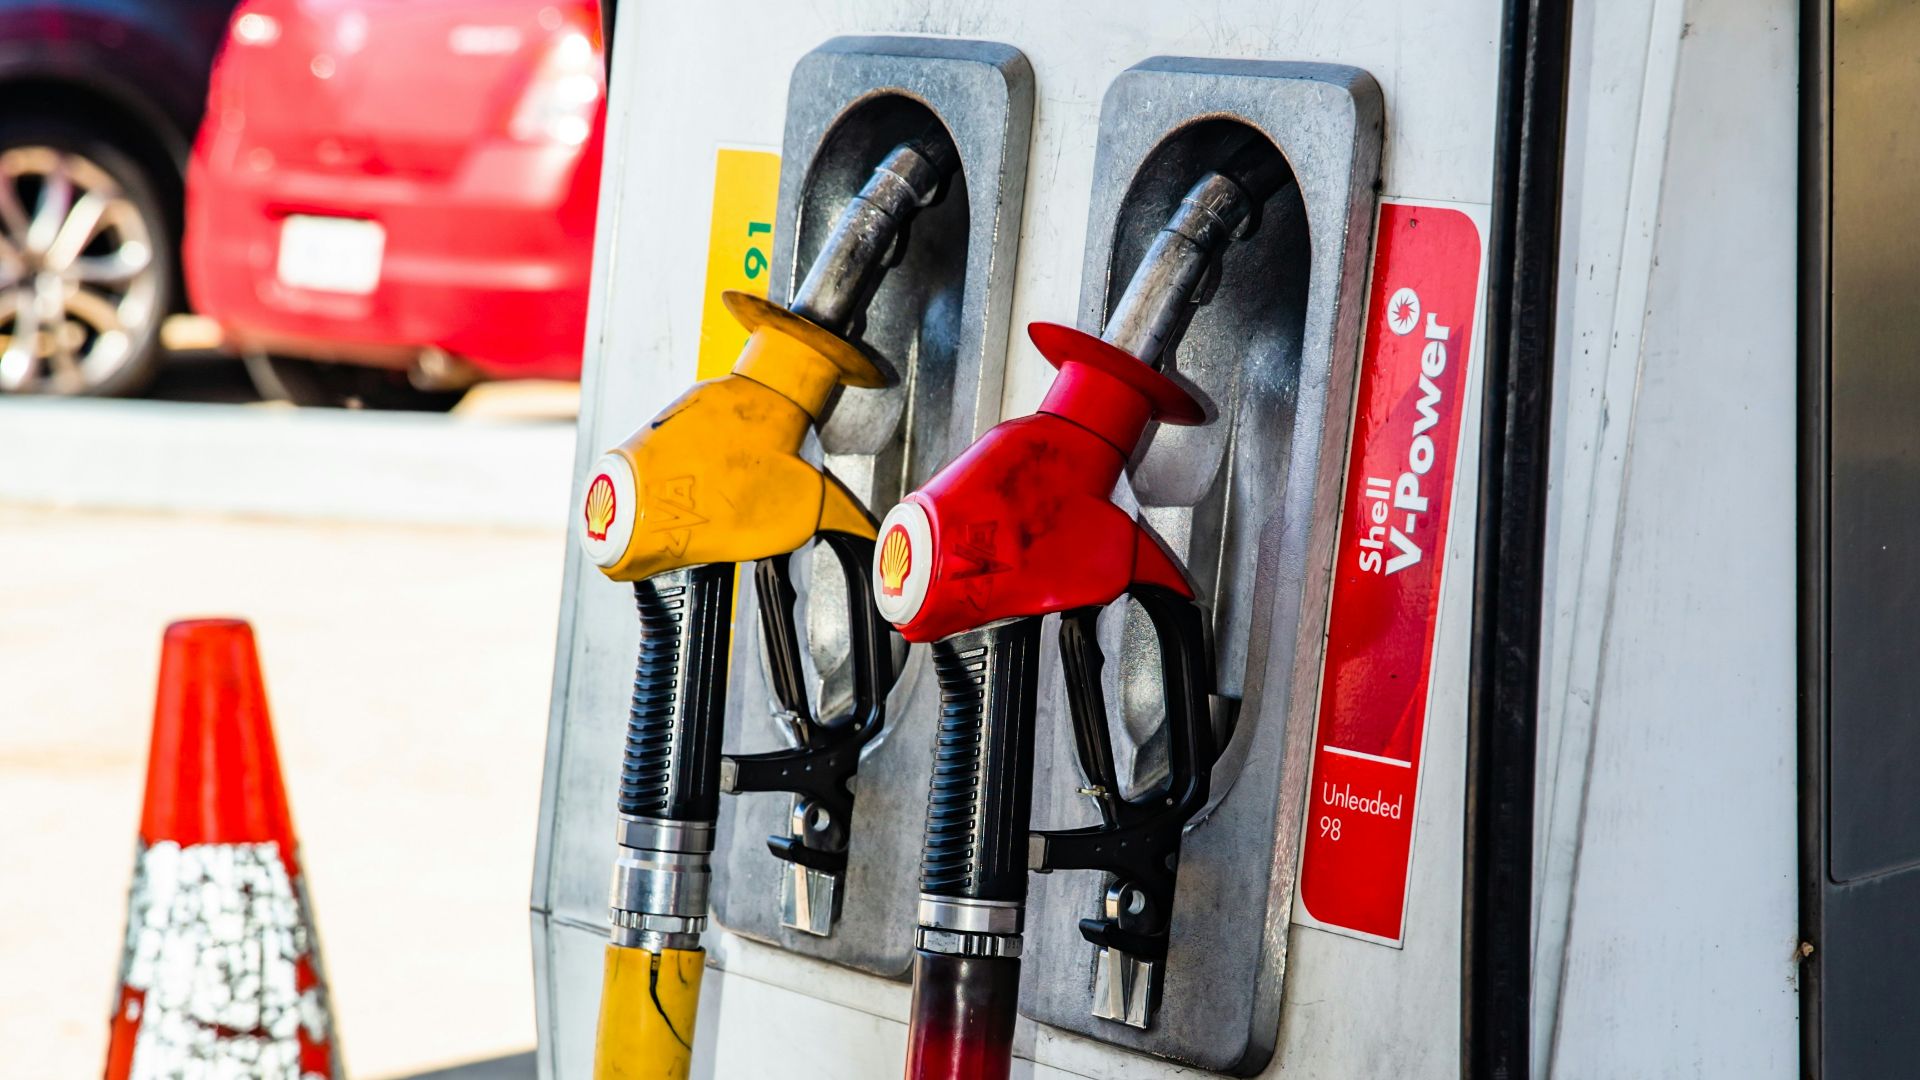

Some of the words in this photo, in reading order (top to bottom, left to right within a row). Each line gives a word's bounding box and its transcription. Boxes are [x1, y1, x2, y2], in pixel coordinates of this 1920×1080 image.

[745, 221, 772, 280] 91
[1385, 312, 1450, 576] V-Power
[1359, 476, 1392, 575] Shell
[1320, 816, 1342, 841] 98
[1322, 782, 1403, 820] Unleaded
